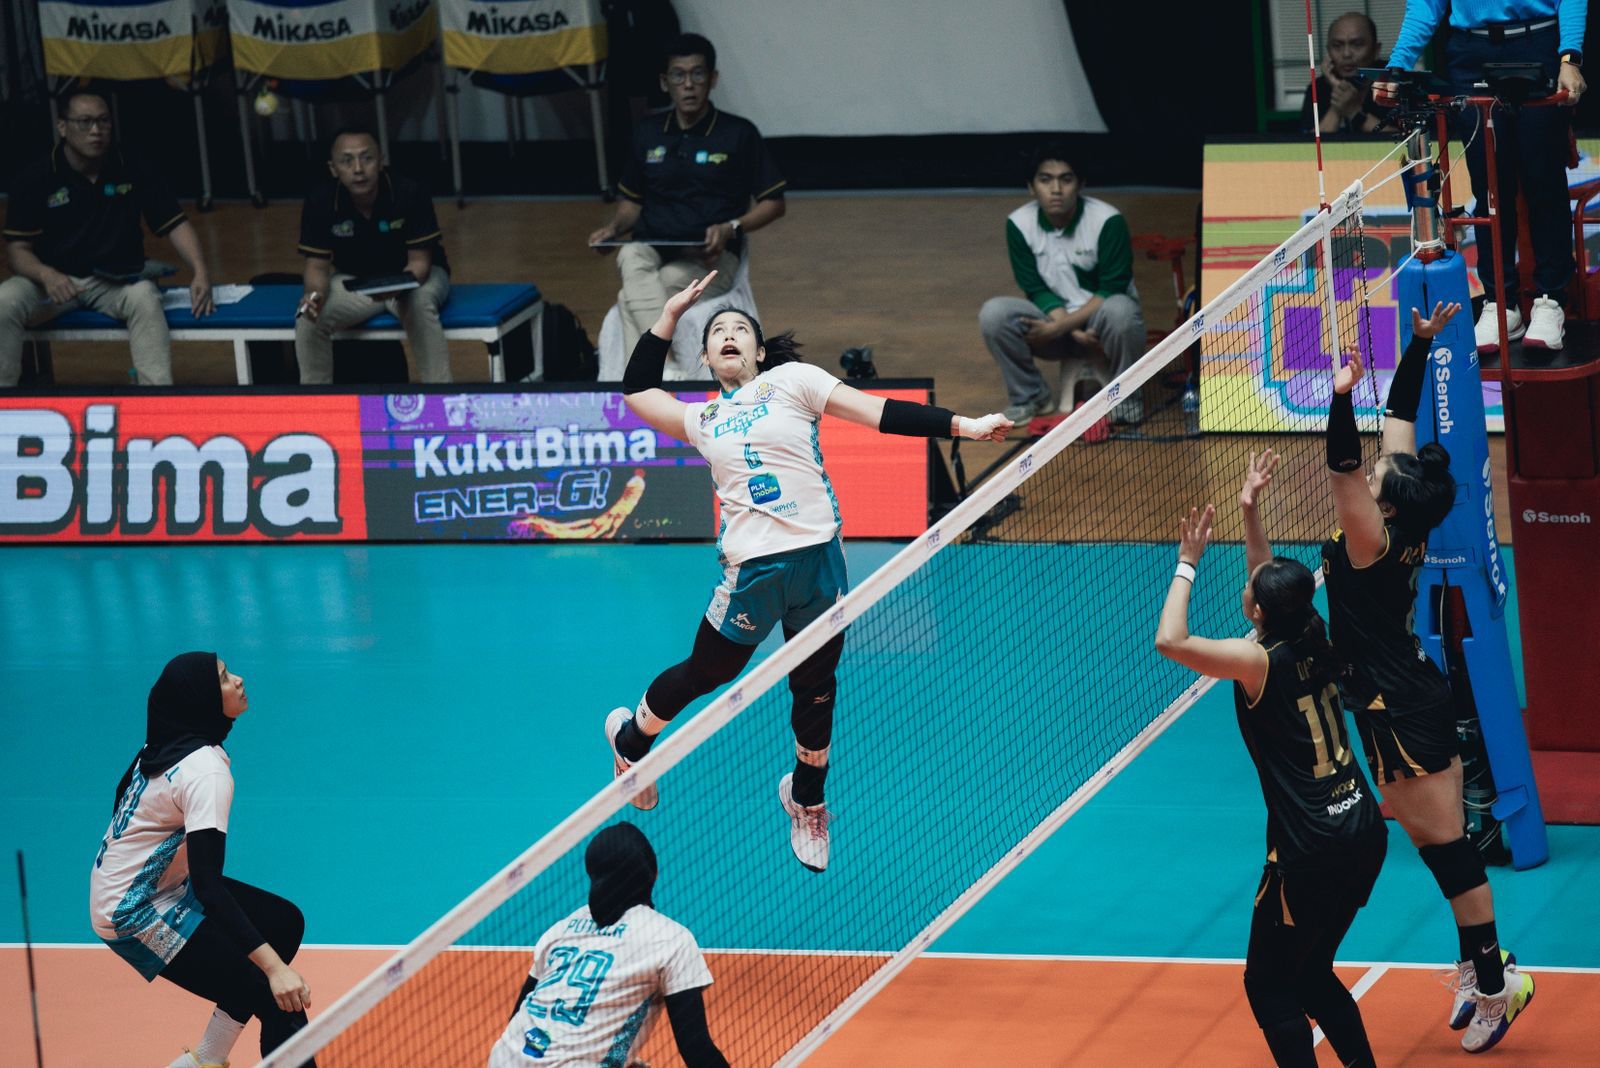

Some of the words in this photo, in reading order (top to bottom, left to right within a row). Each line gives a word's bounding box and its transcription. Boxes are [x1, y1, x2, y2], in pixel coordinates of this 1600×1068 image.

[1436, 367, 1454, 434] Senoh
[0, 403, 338, 527] Bima
[413, 424, 657, 478] KukuBima
[744, 443, 763, 469] 6
[414, 467, 611, 522] ENER-G!
[751, 482, 765, 492] PLN
[753, 486, 778, 498] mobile
[1537, 511, 1591, 524] Senoh
[1430, 555, 1466, 565] Senoh
[525, 946, 614, 1027] 29
